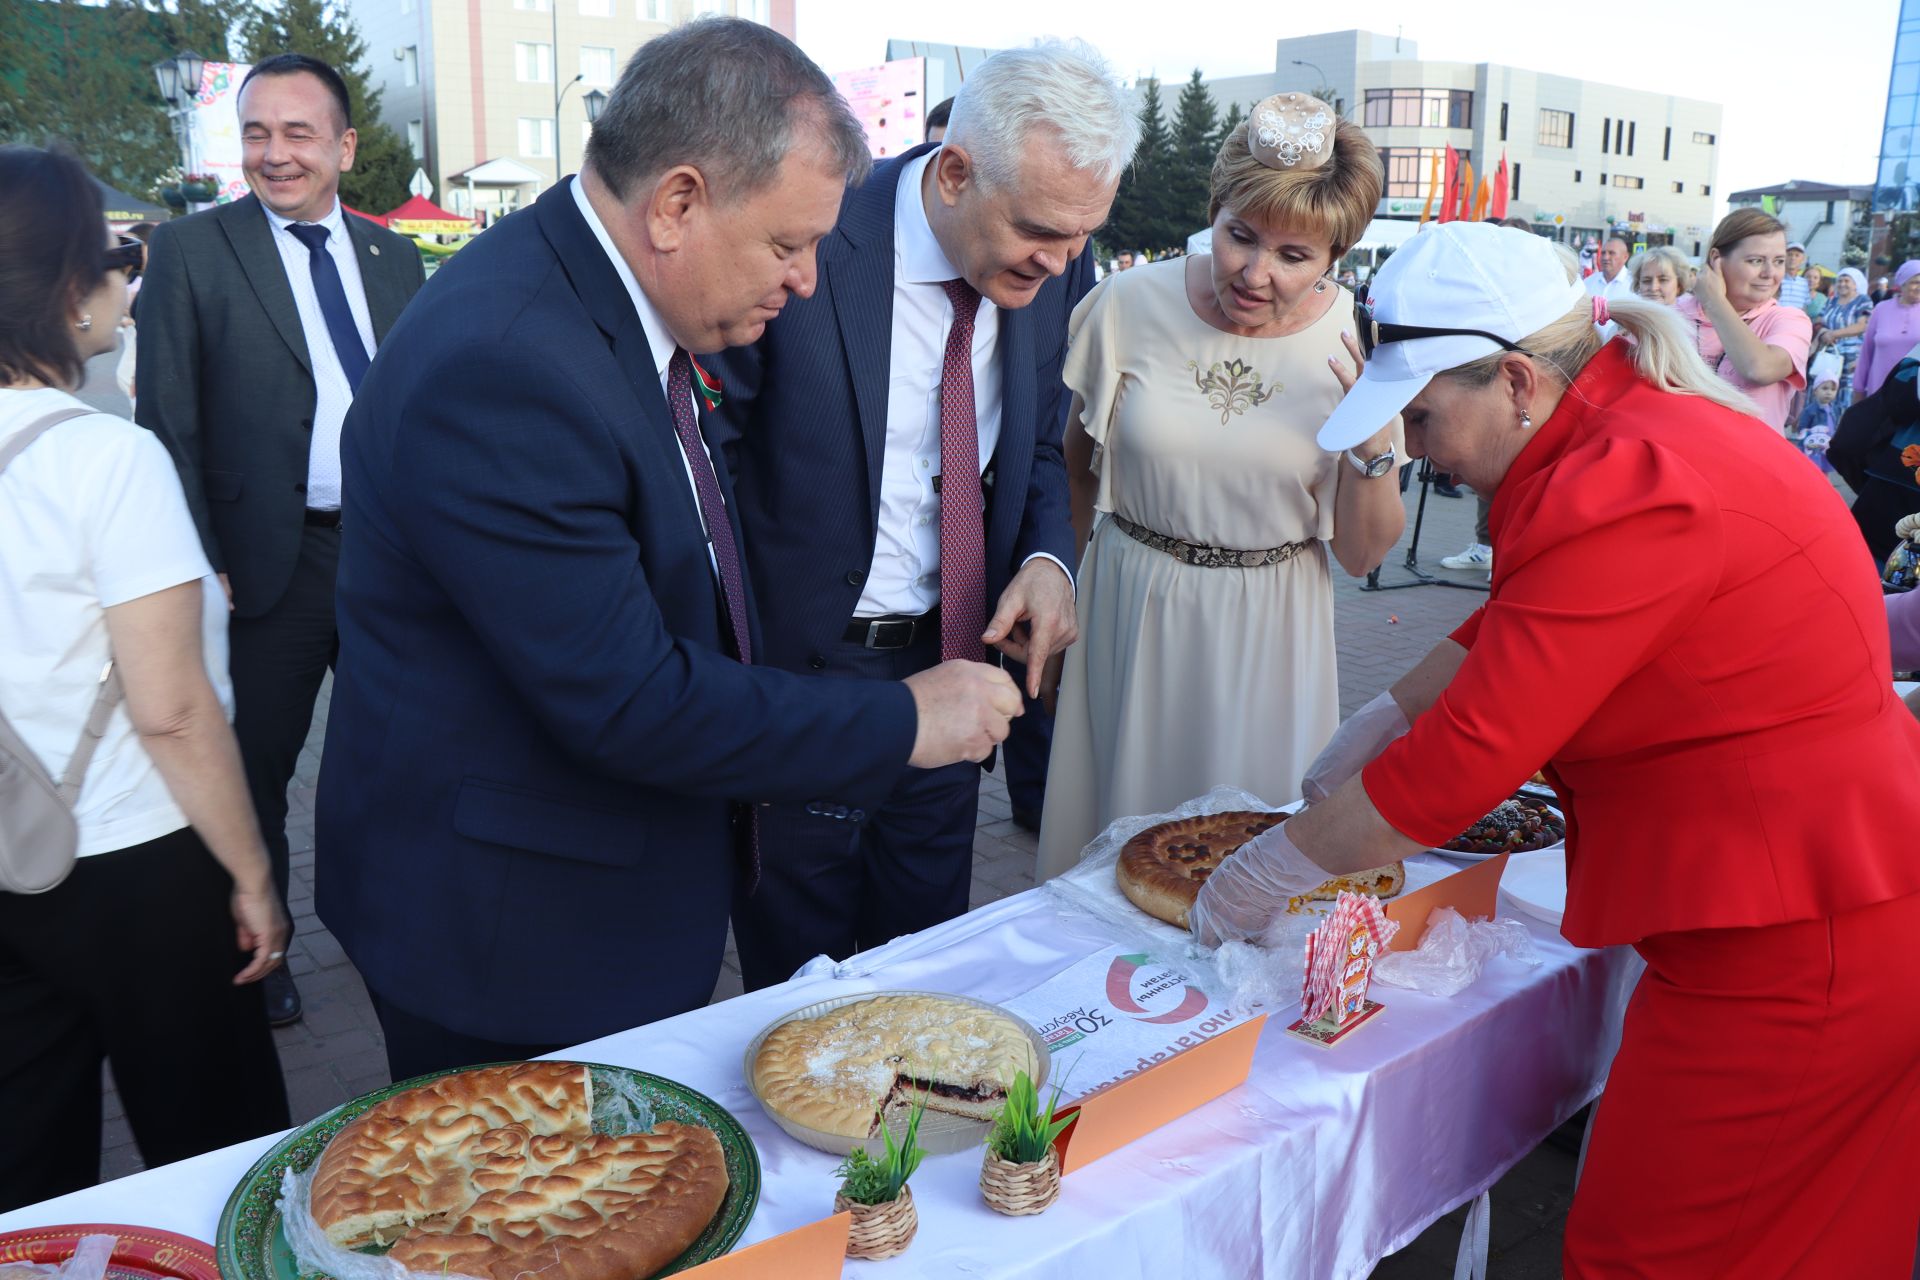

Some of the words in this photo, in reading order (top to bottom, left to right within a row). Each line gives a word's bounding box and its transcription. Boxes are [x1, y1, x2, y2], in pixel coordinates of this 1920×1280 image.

[1038, 1007, 1085, 1035] Август
[1075, 1008, 1114, 1034] 30
[1044, 1028, 1071, 1042] Татар
